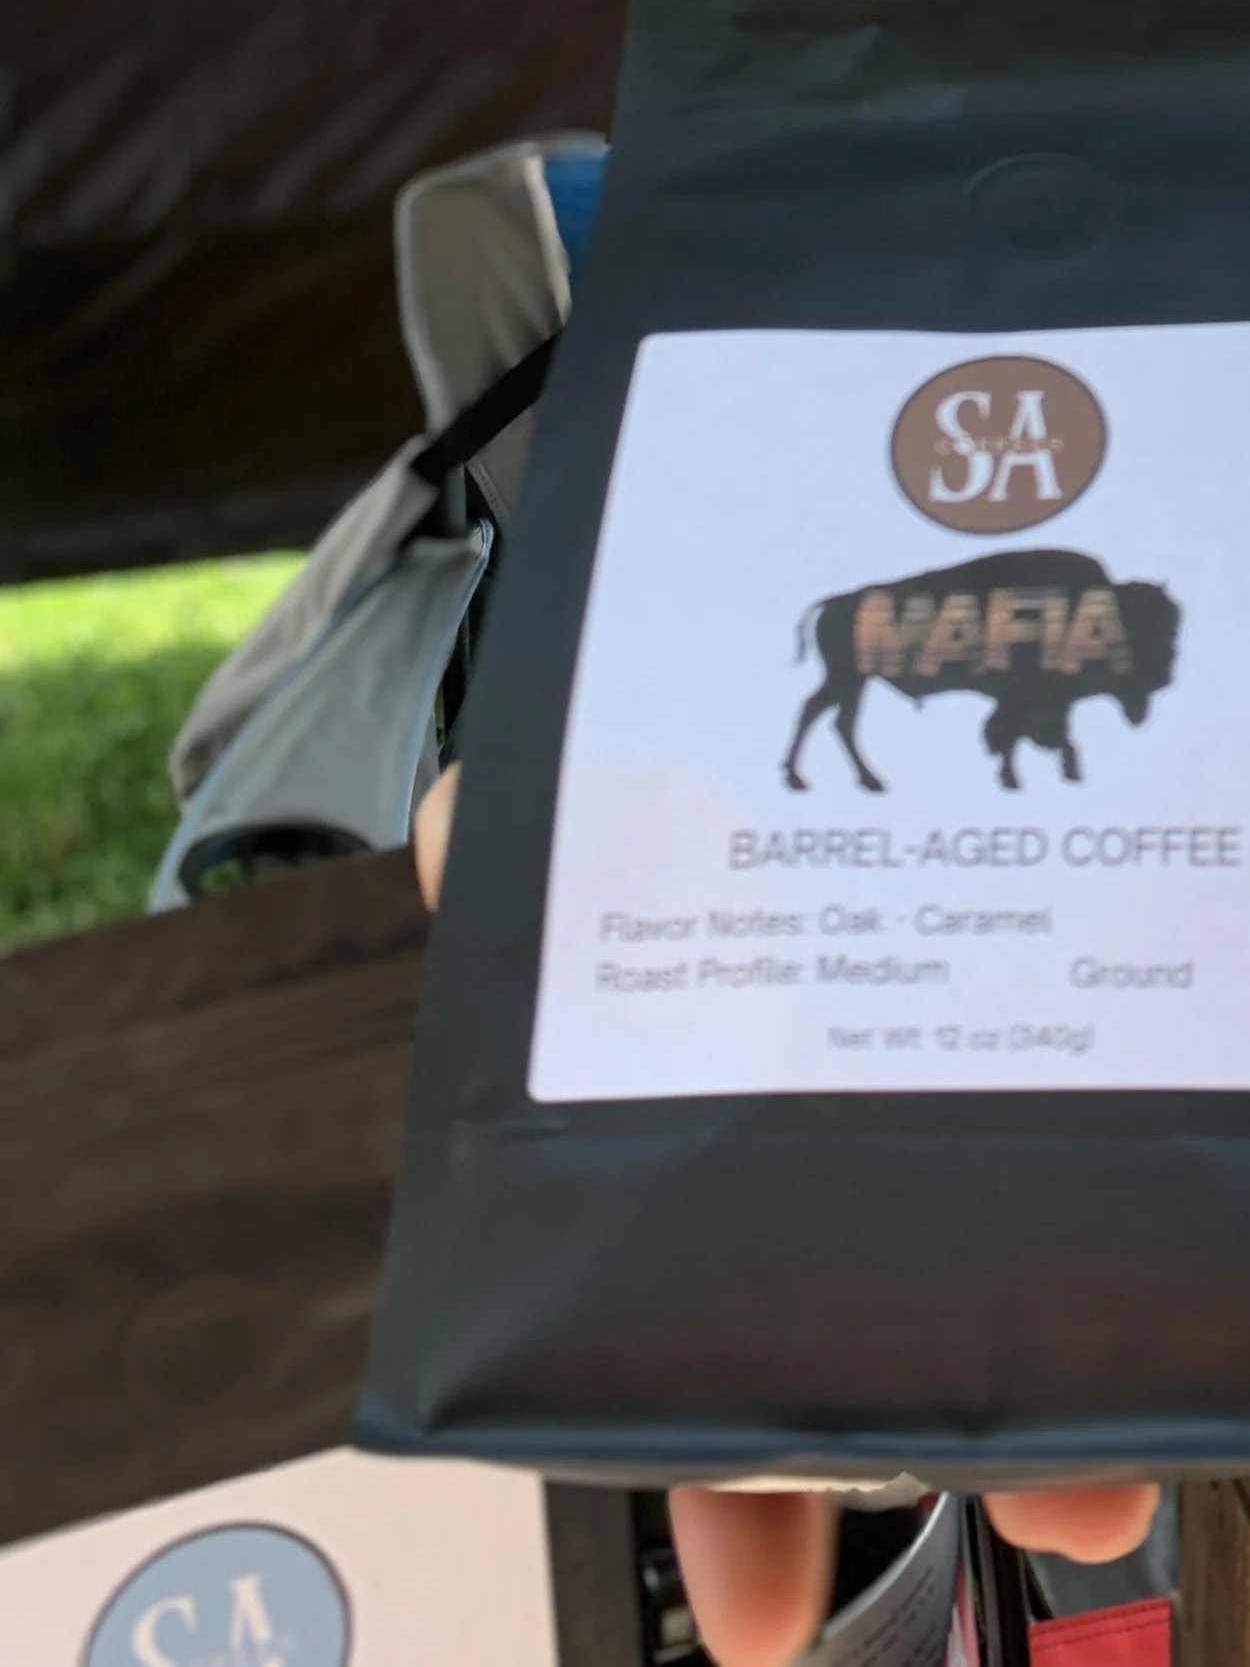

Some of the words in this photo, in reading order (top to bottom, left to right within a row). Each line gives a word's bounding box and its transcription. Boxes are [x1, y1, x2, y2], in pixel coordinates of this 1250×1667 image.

[928, 388, 1064, 504] SA
[854, 587, 1134, 676] MAFIA
[728, 826, 1049, 871] BARREL-AGED
[1060, 825, 1244, 869] COFFEE
[599, 910, 699, 943] Flavor
[706, 908, 807, 939] Notes:
[818, 903, 885, 937] Oak
[912, 902, 1053, 937] Caramel
[595, 959, 689, 993] Roast
[815, 953, 950, 987] Medium
[1069, 955, 1195, 990] Ground
[827, 1025, 875, 1050] Net
[934, 1024, 962, 1051] 12
